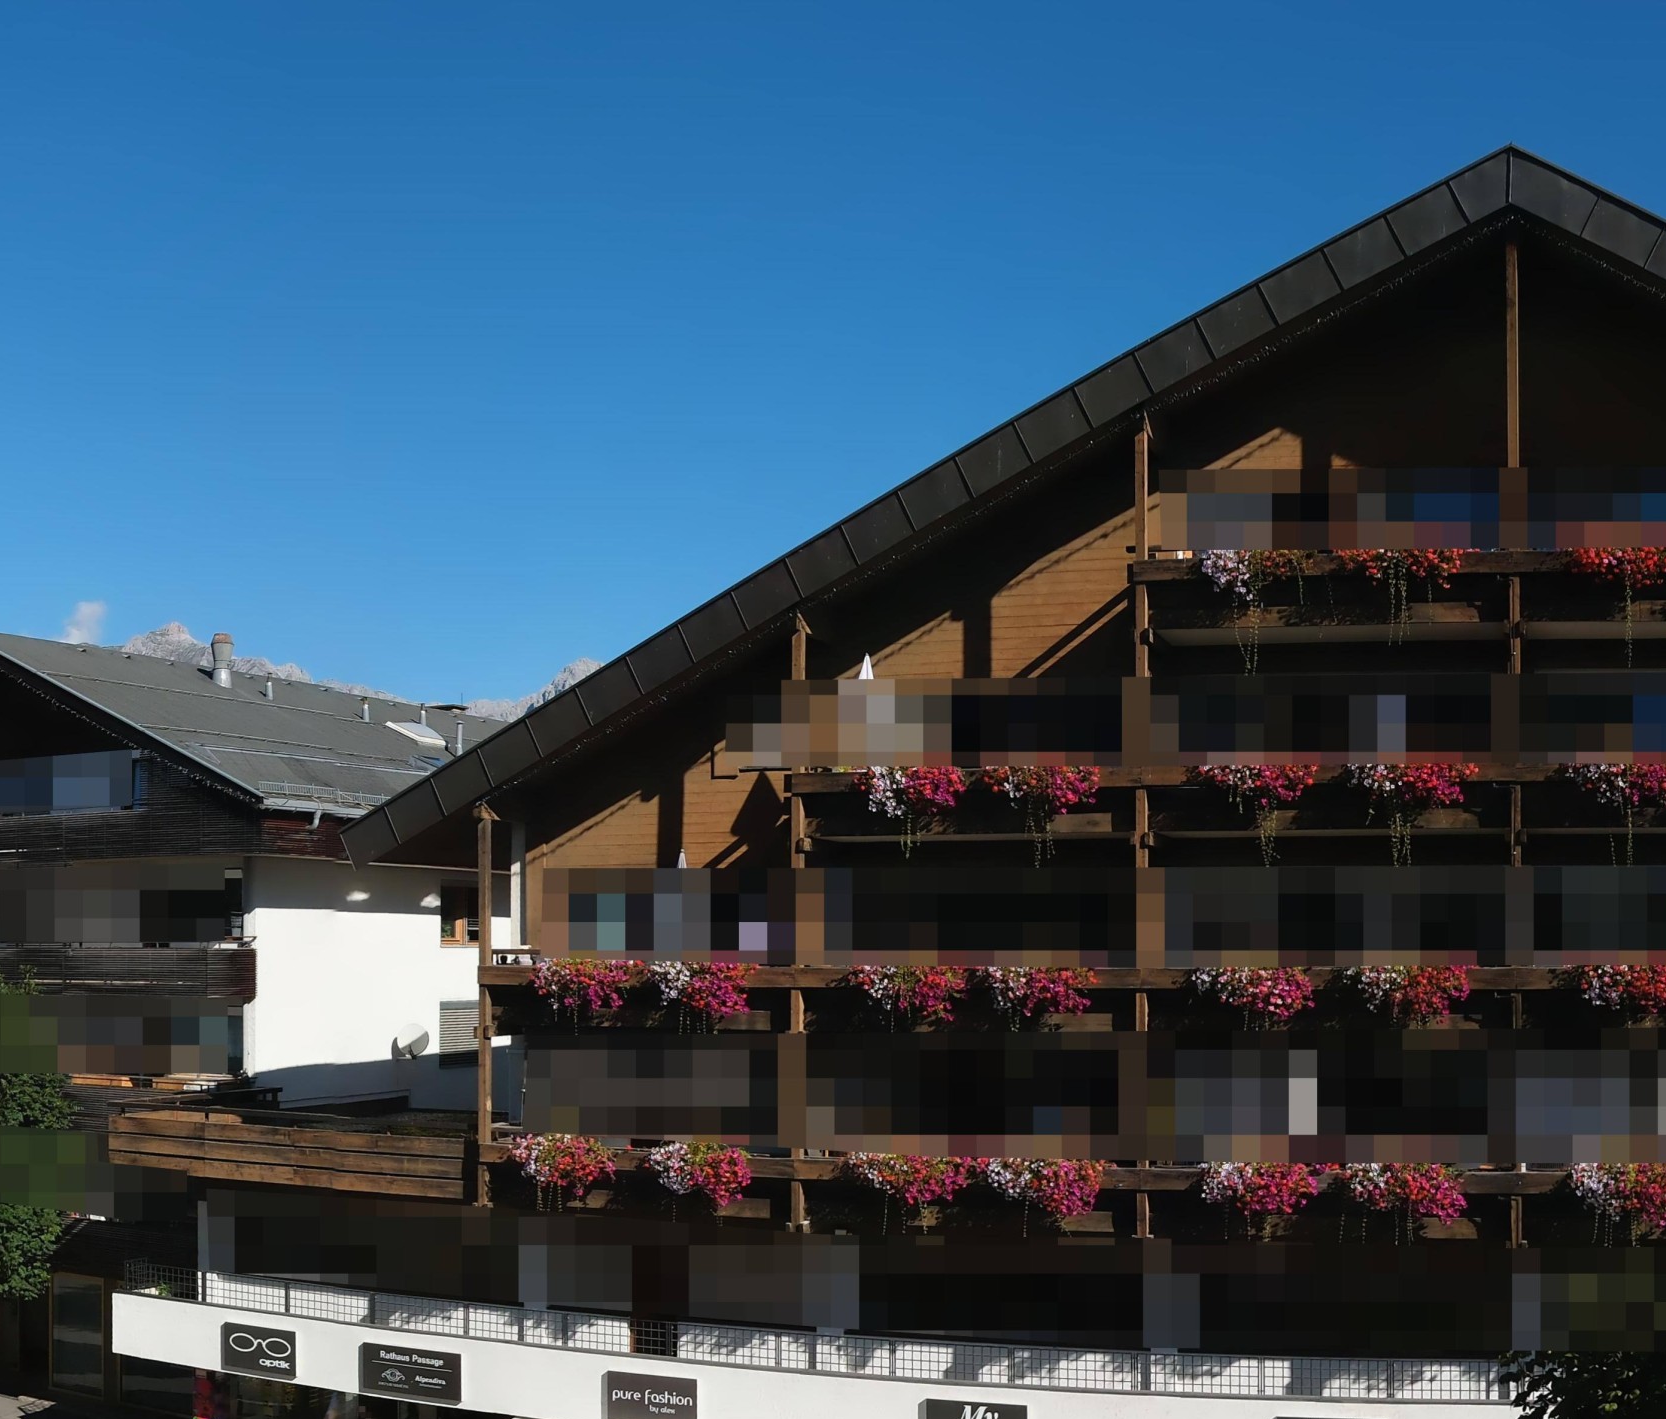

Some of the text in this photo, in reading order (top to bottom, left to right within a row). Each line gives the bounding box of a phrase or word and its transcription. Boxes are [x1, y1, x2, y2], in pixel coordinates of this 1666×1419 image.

[259, 1358, 291, 1370] optik
[379, 1351, 444, 1366] Rathaus Passage
[613, 1389, 693, 1407] pure fashion
[649, 1405, 659, 1414] by
